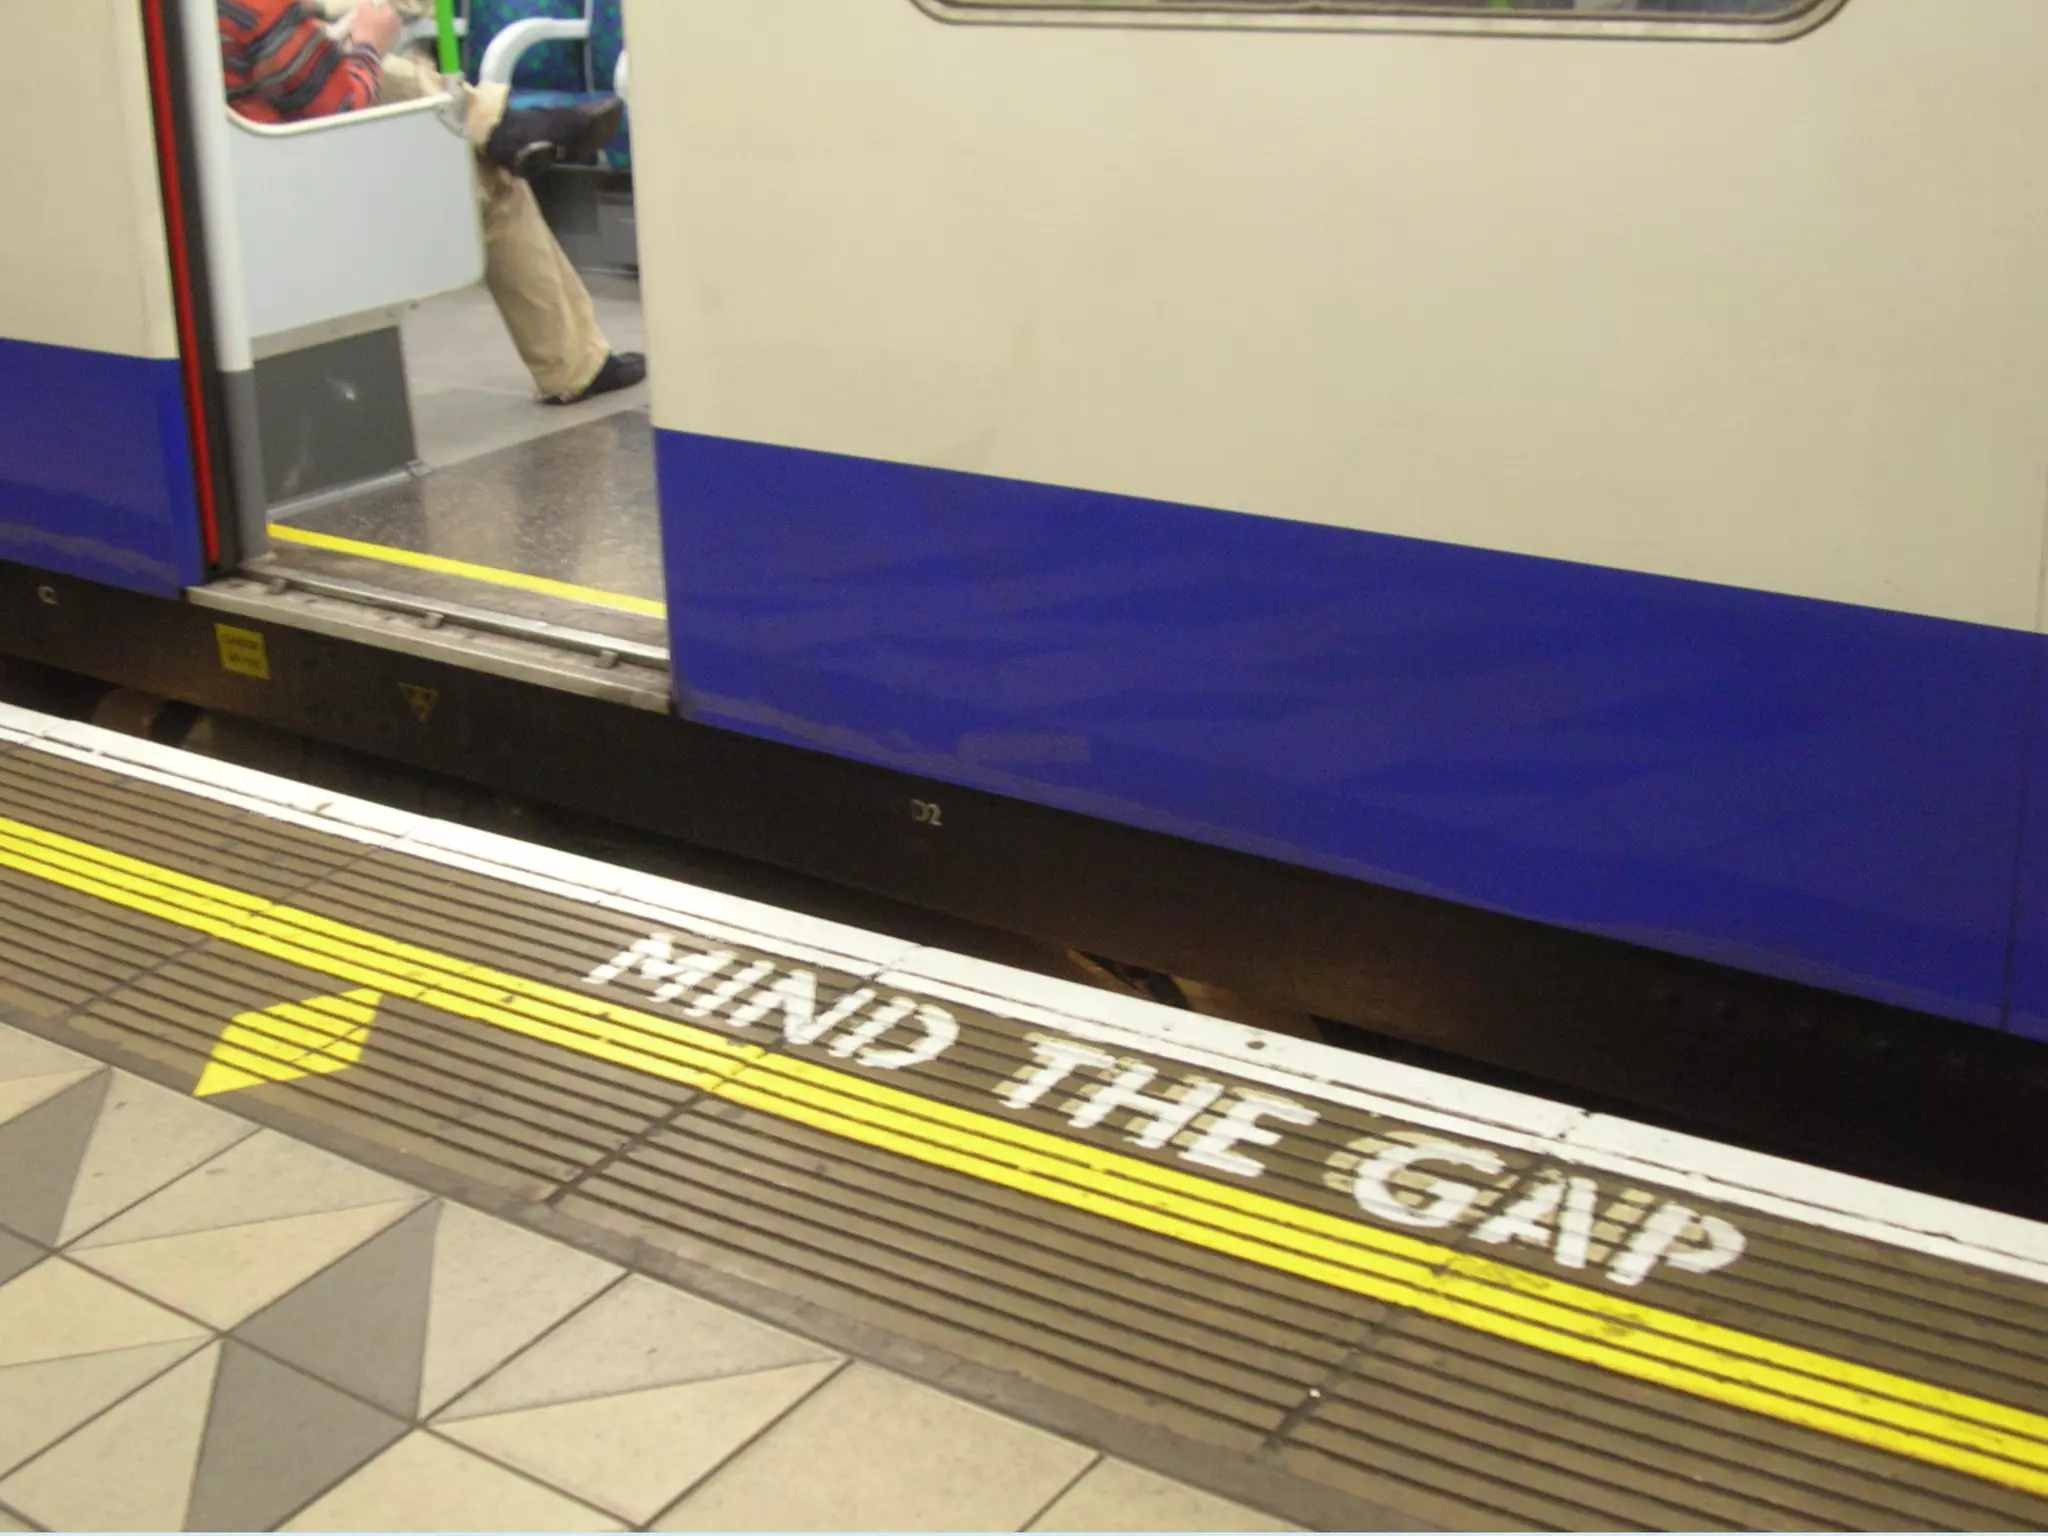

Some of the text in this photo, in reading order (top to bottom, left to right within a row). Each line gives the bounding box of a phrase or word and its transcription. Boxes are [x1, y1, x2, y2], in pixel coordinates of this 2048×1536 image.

[585, 931, 1747, 1287] MIND THE GAP
